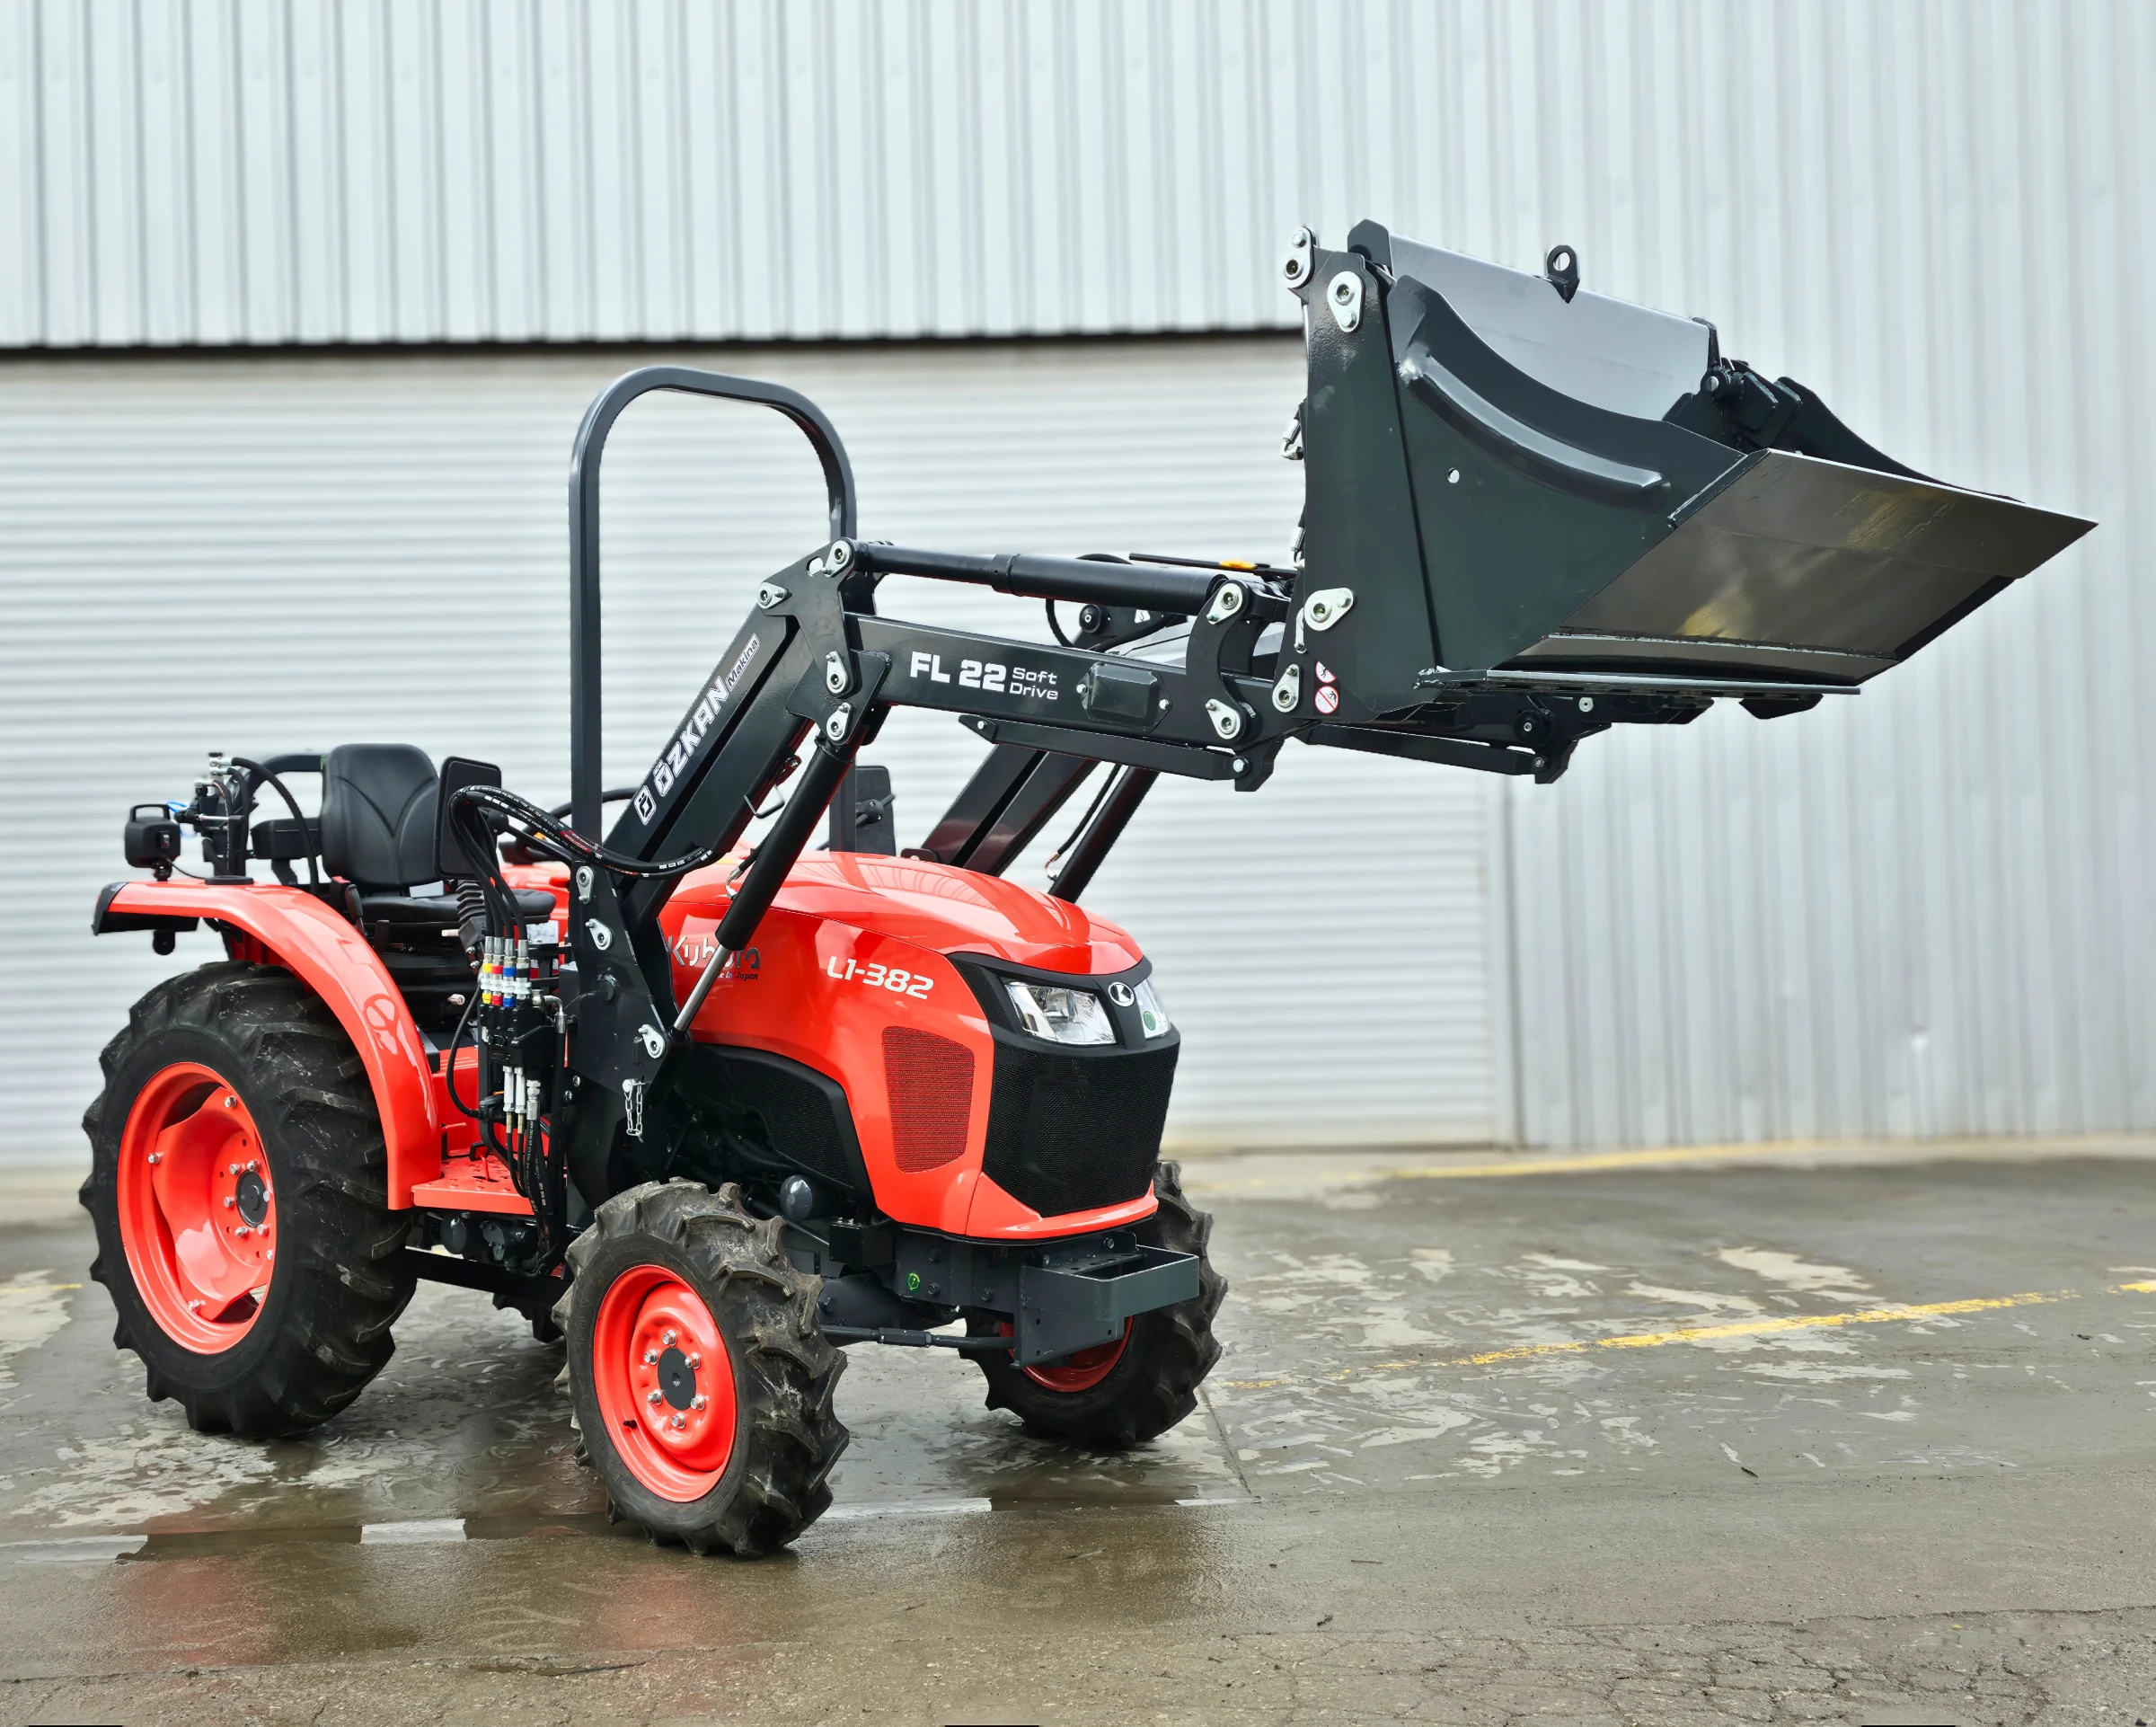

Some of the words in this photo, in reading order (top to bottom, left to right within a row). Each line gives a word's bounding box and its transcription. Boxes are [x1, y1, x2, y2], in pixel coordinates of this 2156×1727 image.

[909, 651, 950, 683] FL
[959, 659, 1007, 693] 22
[1012, 667, 1058, 685] Soft
[1009, 682, 1059, 700] Drive
[653, 676, 729, 797] ÖZKAN
[725, 633, 760, 690] Makina
[736, 971, 758, 981] Japan
[826, 955, 934, 1000] L1-382
